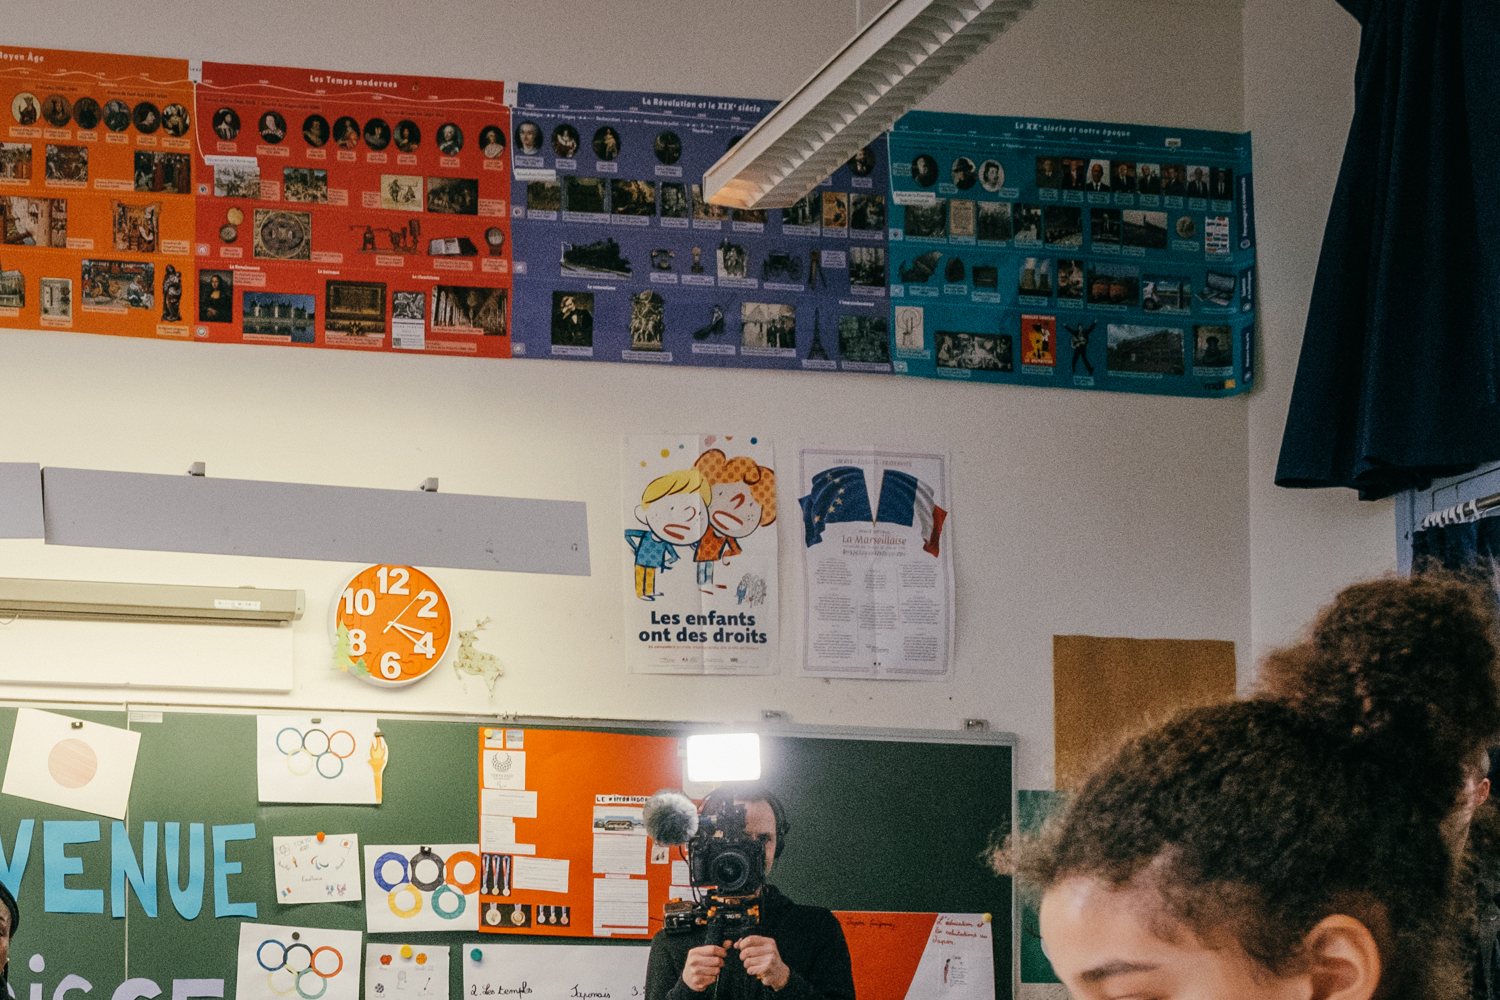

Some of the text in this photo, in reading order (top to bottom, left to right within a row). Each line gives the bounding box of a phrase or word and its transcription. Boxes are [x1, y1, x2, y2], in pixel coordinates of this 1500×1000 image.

[27, 51, 44, 63] Âge
[310, 74, 398, 89] Les Temps modernes
[642, 97, 652, 106] La
[653, 97, 696, 108] Révolution
[698, 99, 706, 108] et
[708, 100, 716, 109] le
[738, 104, 761, 113] siècle
[1014, 121, 1024, 130] Le
[1043, 123, 1066, 133] siècle
[1067, 125, 1076, 134] et
[1079, 126, 1100, 135] notre
[1102, 127, 1131, 138] époque
[855, 534, 907, 545] Marseillaise
[376, 566, 410, 596] 12
[342, 587, 376, 616] 10
[416, 590, 439, 618] 2
[651, 610, 756, 626] Les enfants
[348, 628, 367, 656] 8
[638, 626, 768, 644] ont des droits
[413, 631, 436, 659] 4
[380, 651, 402, 680] 6
